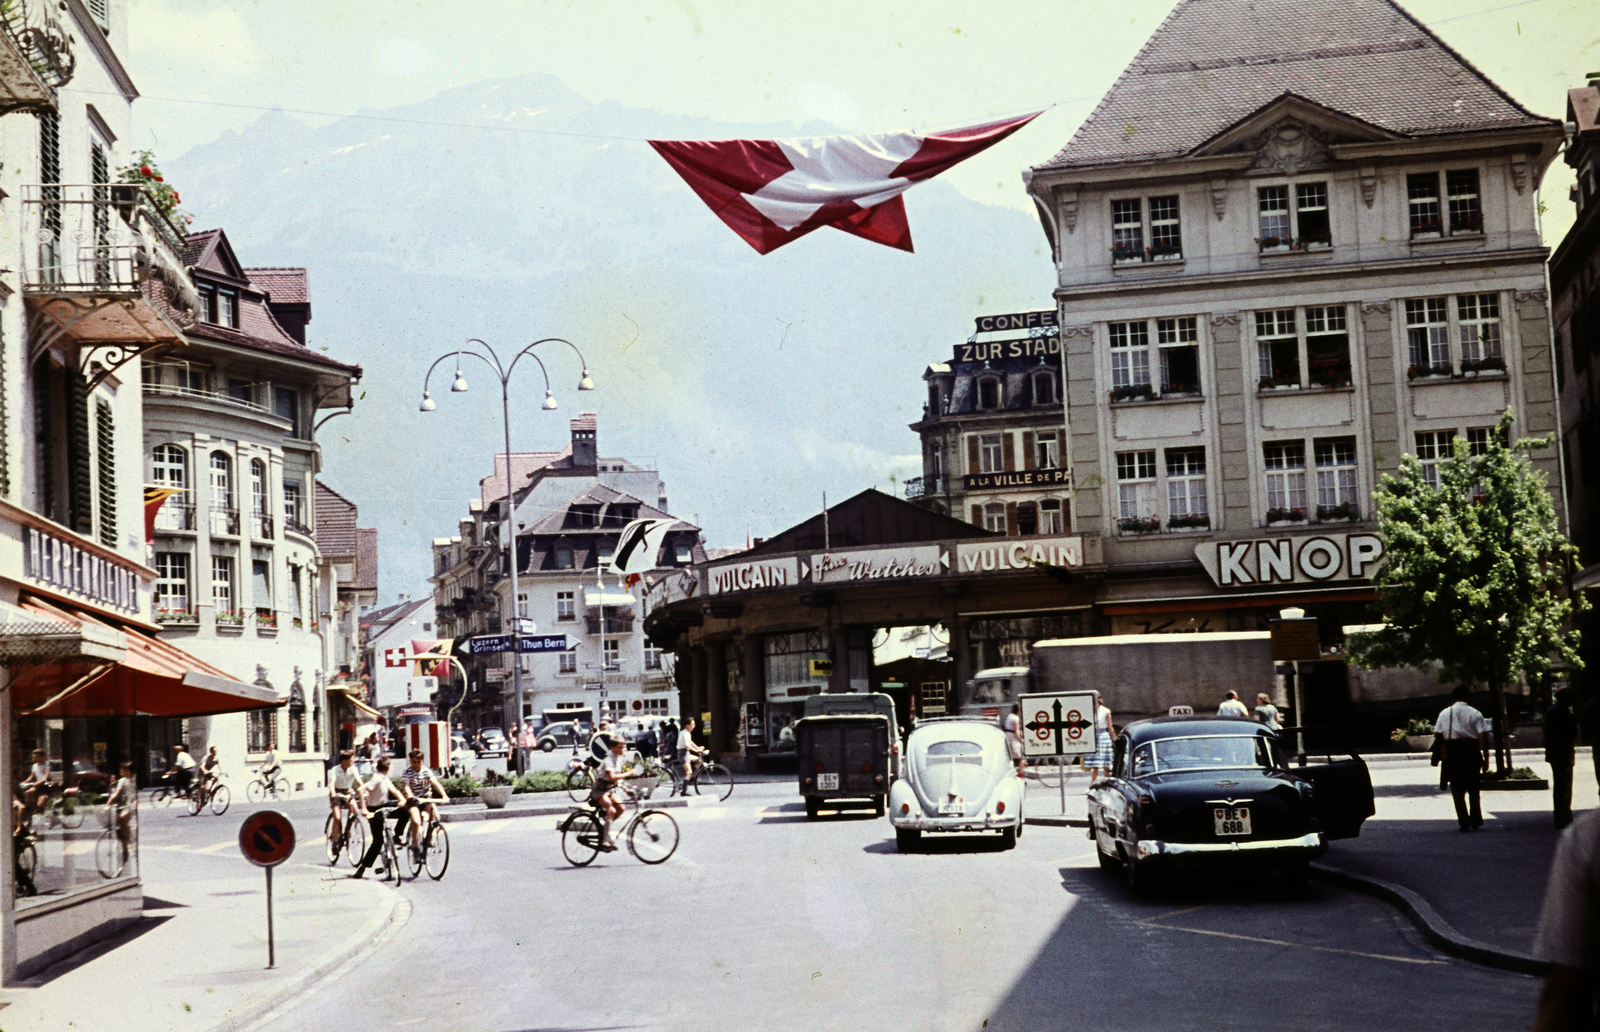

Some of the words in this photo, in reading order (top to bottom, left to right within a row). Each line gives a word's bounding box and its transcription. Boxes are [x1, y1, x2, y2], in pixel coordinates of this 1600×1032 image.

[981, 312, 1060, 331] CONFE
[961, 342, 1003, 362] ZUR
[1008, 337, 1060, 358] STAD
[969, 478, 976, 486] A
[978, 477, 990, 486] LA
[994, 473, 1033, 486] VILLE
[1037, 473, 1050, 482] DE
[963, 541, 1077, 572] VULCAIN
[1216, 533, 1386, 586] KNOP
[815, 552, 847, 580] fine
[848, 557, 935, 580] Watches
[713, 562, 786, 594] VULCAIN
[471, 638, 500, 647] Luzern
[473, 644, 504, 653] Grimsel
[522, 639, 543, 649] Thun
[544, 638, 565, 648] Bern
[1224, 809, 1239, 820] BE
[1222, 820, 1243, 833] 688
